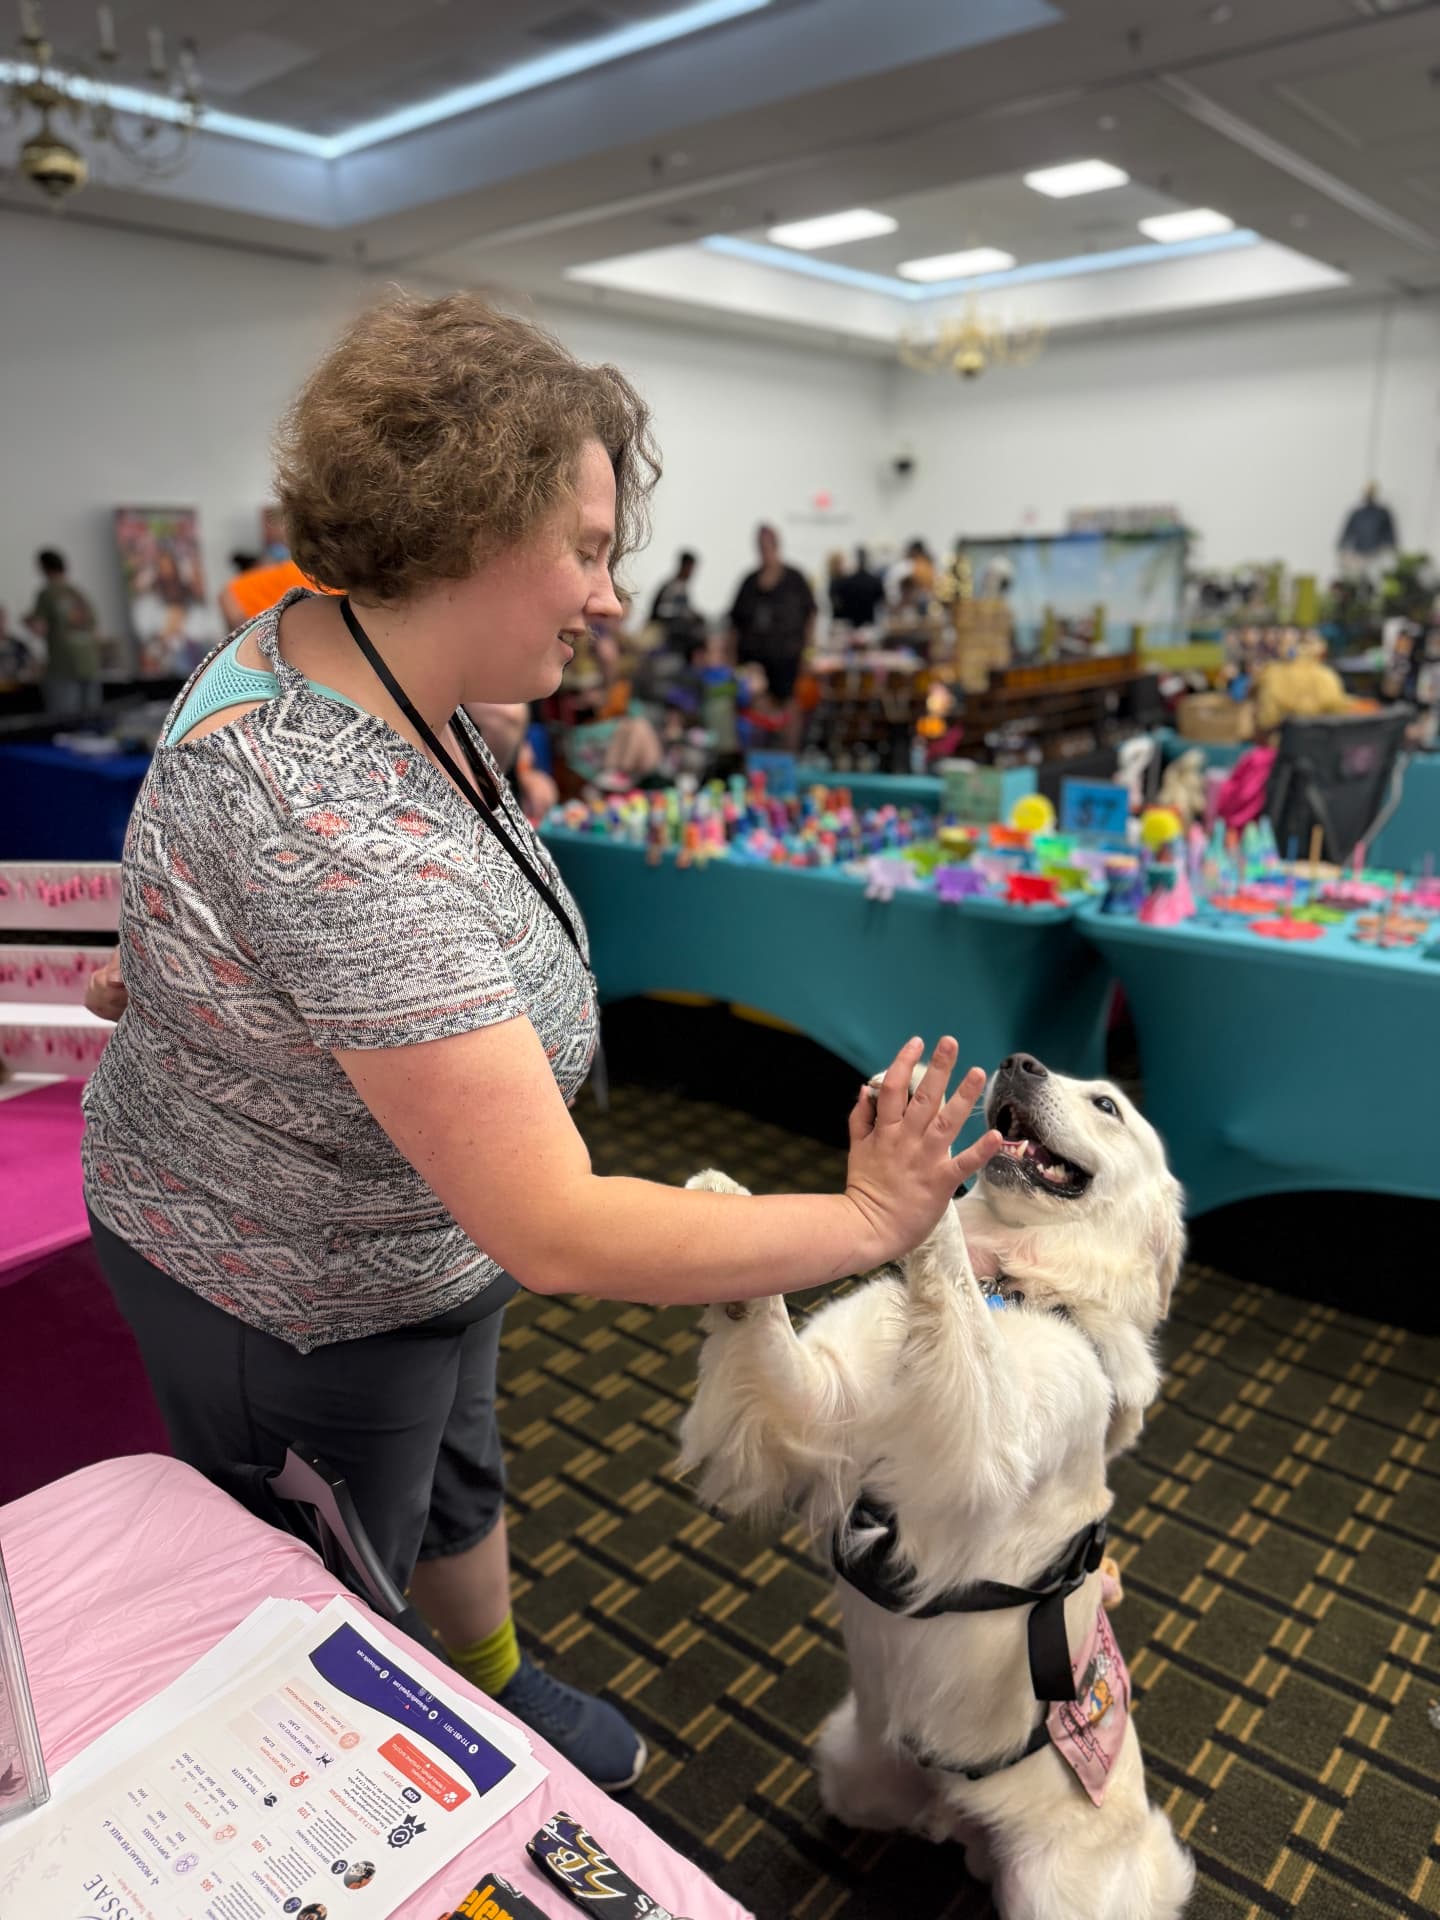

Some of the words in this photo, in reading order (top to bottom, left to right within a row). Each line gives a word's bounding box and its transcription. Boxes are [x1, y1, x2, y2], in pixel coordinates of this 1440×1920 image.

[231, 1769, 248, 1784] MASTER
[245, 1782, 258, 1795] TRICK
[404, 1788, 418, 1802] $250
[329, 1788, 348, 1807] PROGRAM
[297, 1807, 311, 1819] $120
[345, 1805, 360, 1818] PUPPY
[110, 1827, 124, 1842] WEEK
[142, 1828, 160, 1847] CLASSES
[295, 1829, 311, 1846] TRAINING
[370, 1827, 381, 1836] AKC
[120, 1841, 132, 1851] PER
[157, 1845, 171, 1860] PUPPY
[251, 1840, 265, 1853] $120
[308, 1843, 319, 1853] DOG
[128, 1849, 152, 1878] PROGRAMS
[316, 1851, 330, 1865] SERVICE
[200, 1878, 214, 1892] $65
[251, 1870, 266, 1886] BASICS
[84, 1875, 133, 1920] SSAE
[263, 1883, 281, 1904] TRAINING
